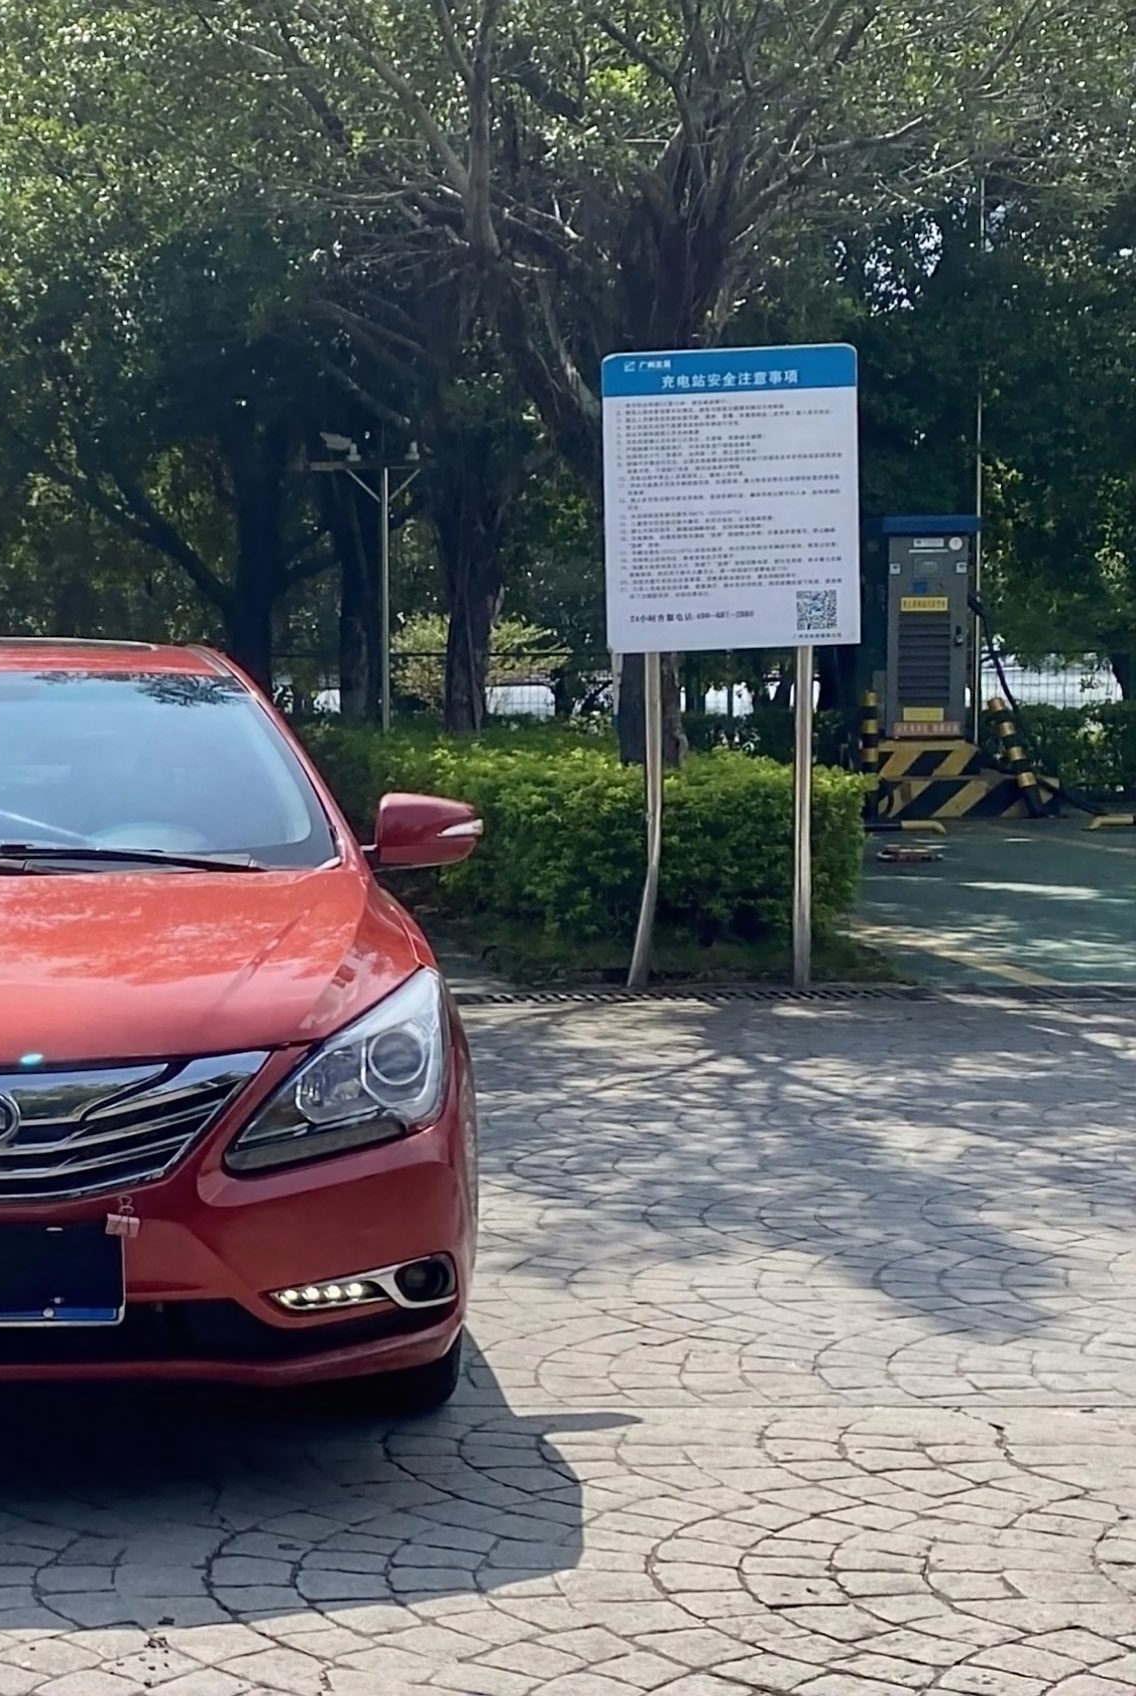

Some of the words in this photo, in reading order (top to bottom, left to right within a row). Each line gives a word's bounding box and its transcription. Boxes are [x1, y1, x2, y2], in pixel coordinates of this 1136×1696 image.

[661, 369, 799, 389] 充电站安全注意事项
